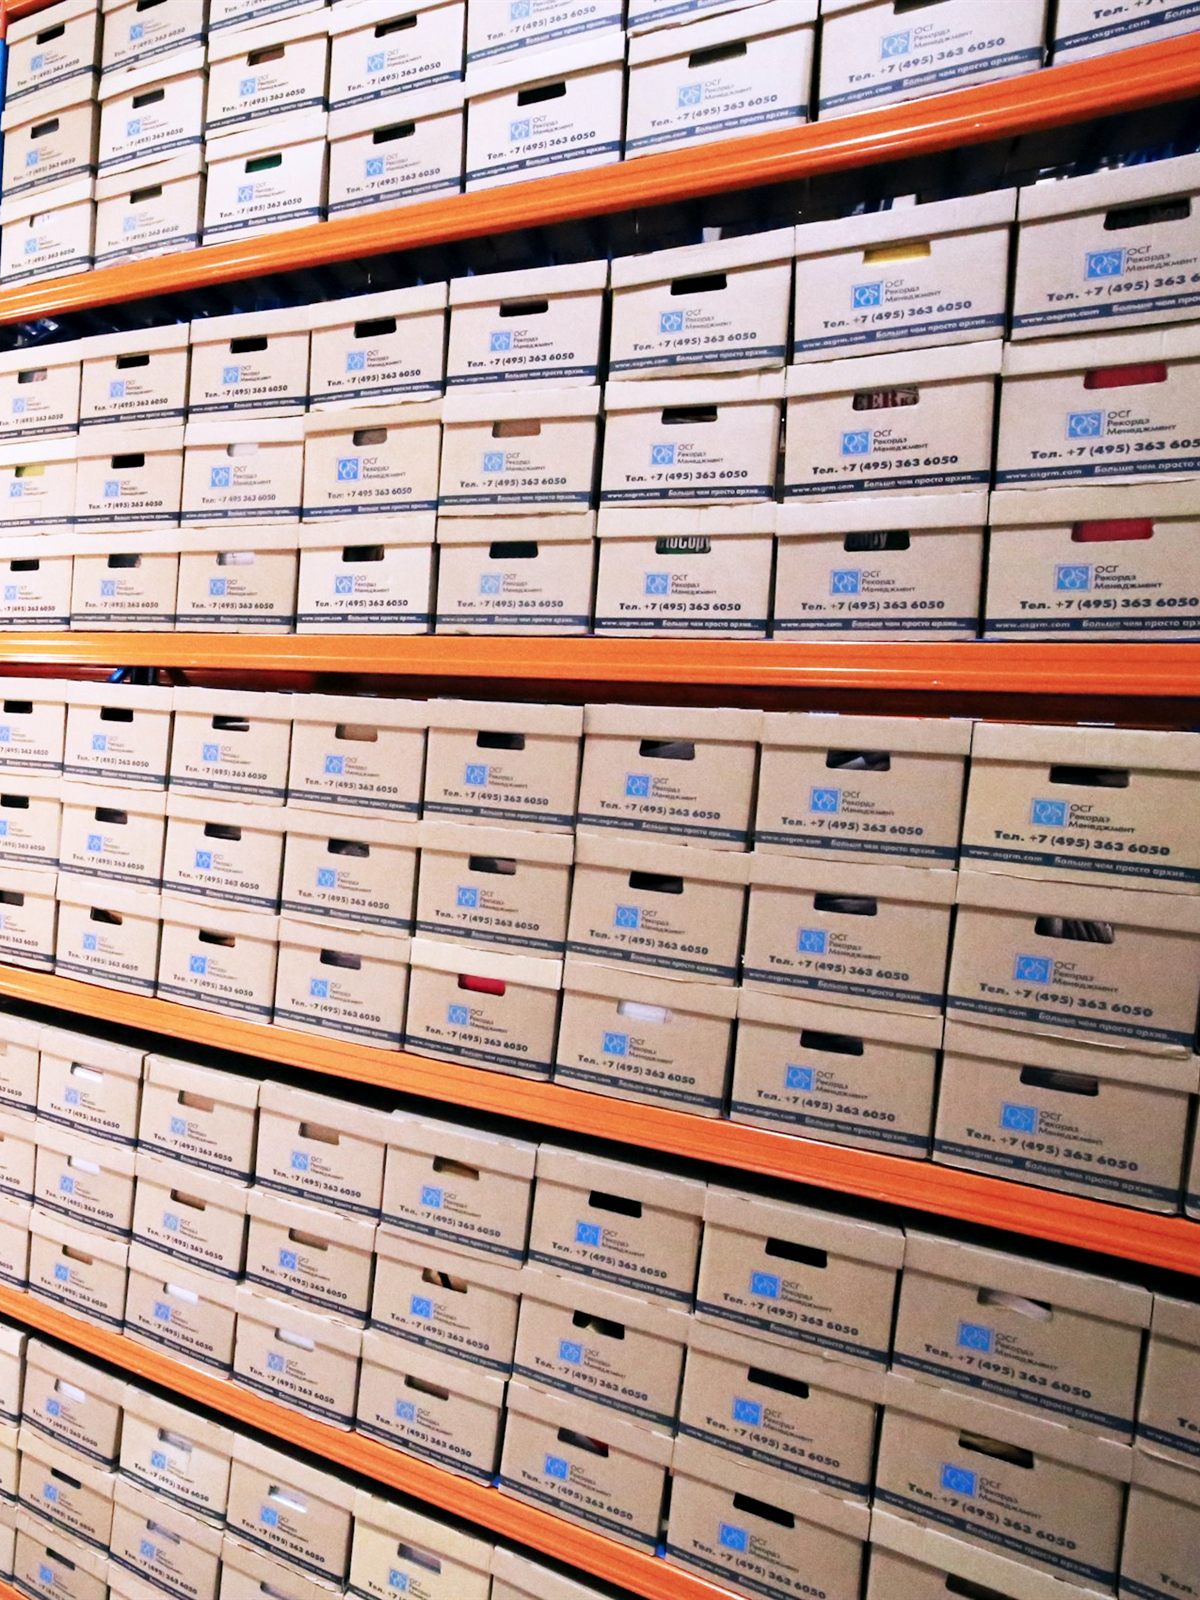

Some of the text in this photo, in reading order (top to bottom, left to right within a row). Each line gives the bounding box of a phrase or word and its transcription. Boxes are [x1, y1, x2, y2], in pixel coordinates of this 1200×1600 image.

[1093, 7, 1129, 19] Тел.
[848, 36, 1005, 83] Тел. +7 (495) 363 6050
[1127, 245, 1153, 256] ОСГ
[1125, 256, 1199, 274] Менеджмент
[884, 279, 904, 289] ОСГ
[1047, 275, 1185, 302] Тел. +7 (495) 363
[822, 300, 971, 329] Тел. +7 (495) 363 6050
[1107, 410, 1132, 419] ОСГ
[873, 429, 892, 438] ОСГ
[1106, 424, 1176, 436] Менеджмент
[1030, 449, 1062, 460] Тел.
[1067, 447, 1086, 457] +7
[1089, 444, 1130, 456] (495)
[1134, 442, 1165, 452] 363
[811, 455, 958, 475] Тел. +7 (495) 363 6050
[624, 474, 646, 482] Тел.
[665, 472, 692, 481] (495)
[719, 470, 747, 478] 6050
[358, 489, 373, 497] 495
[374, 488, 389, 496] 363
[391, 486, 412, 495] 6050
[1095, 565, 1119, 573] ОСГ
[1094, 582, 1163, 590] Менеджмент
[801, 602, 826, 610] Тел.
[830, 602, 845, 610] +7
[848, 602, 880, 611] (495)
[910, 601, 944, 609] 6050
[1019, 598, 1199, 610] Тел. +7 (495) 363 6050
[1070, 804, 1093, 812] ОСГ
[782, 817, 806, 826] Тел.
[828, 821, 859, 832] (495)
[862, 824, 886, 832] 363
[889, 826, 923, 835] 6050
[1068, 821, 1135, 834] Менеджмент
[994, 830, 1170, 856] Тел. +7 (495) 363 6050
[769, 955, 909, 981] Тел. +7 (495) 363 6050
[1054, 962, 1077, 971] ОСГ
[979, 983, 1153, 1017] Тел. +7 (495) 363 6050
[966, 1129, 1138, 1172] Тел. +7 (495) 363 6050
[551, 1241, 666, 1279] Тел. +7 (495) 363 6050
[722, 1292, 858, 1336] Тел. +7 (495) 363 6050
[924, 1344, 1091, 1399] Тел. +7 (495) 363 6050
